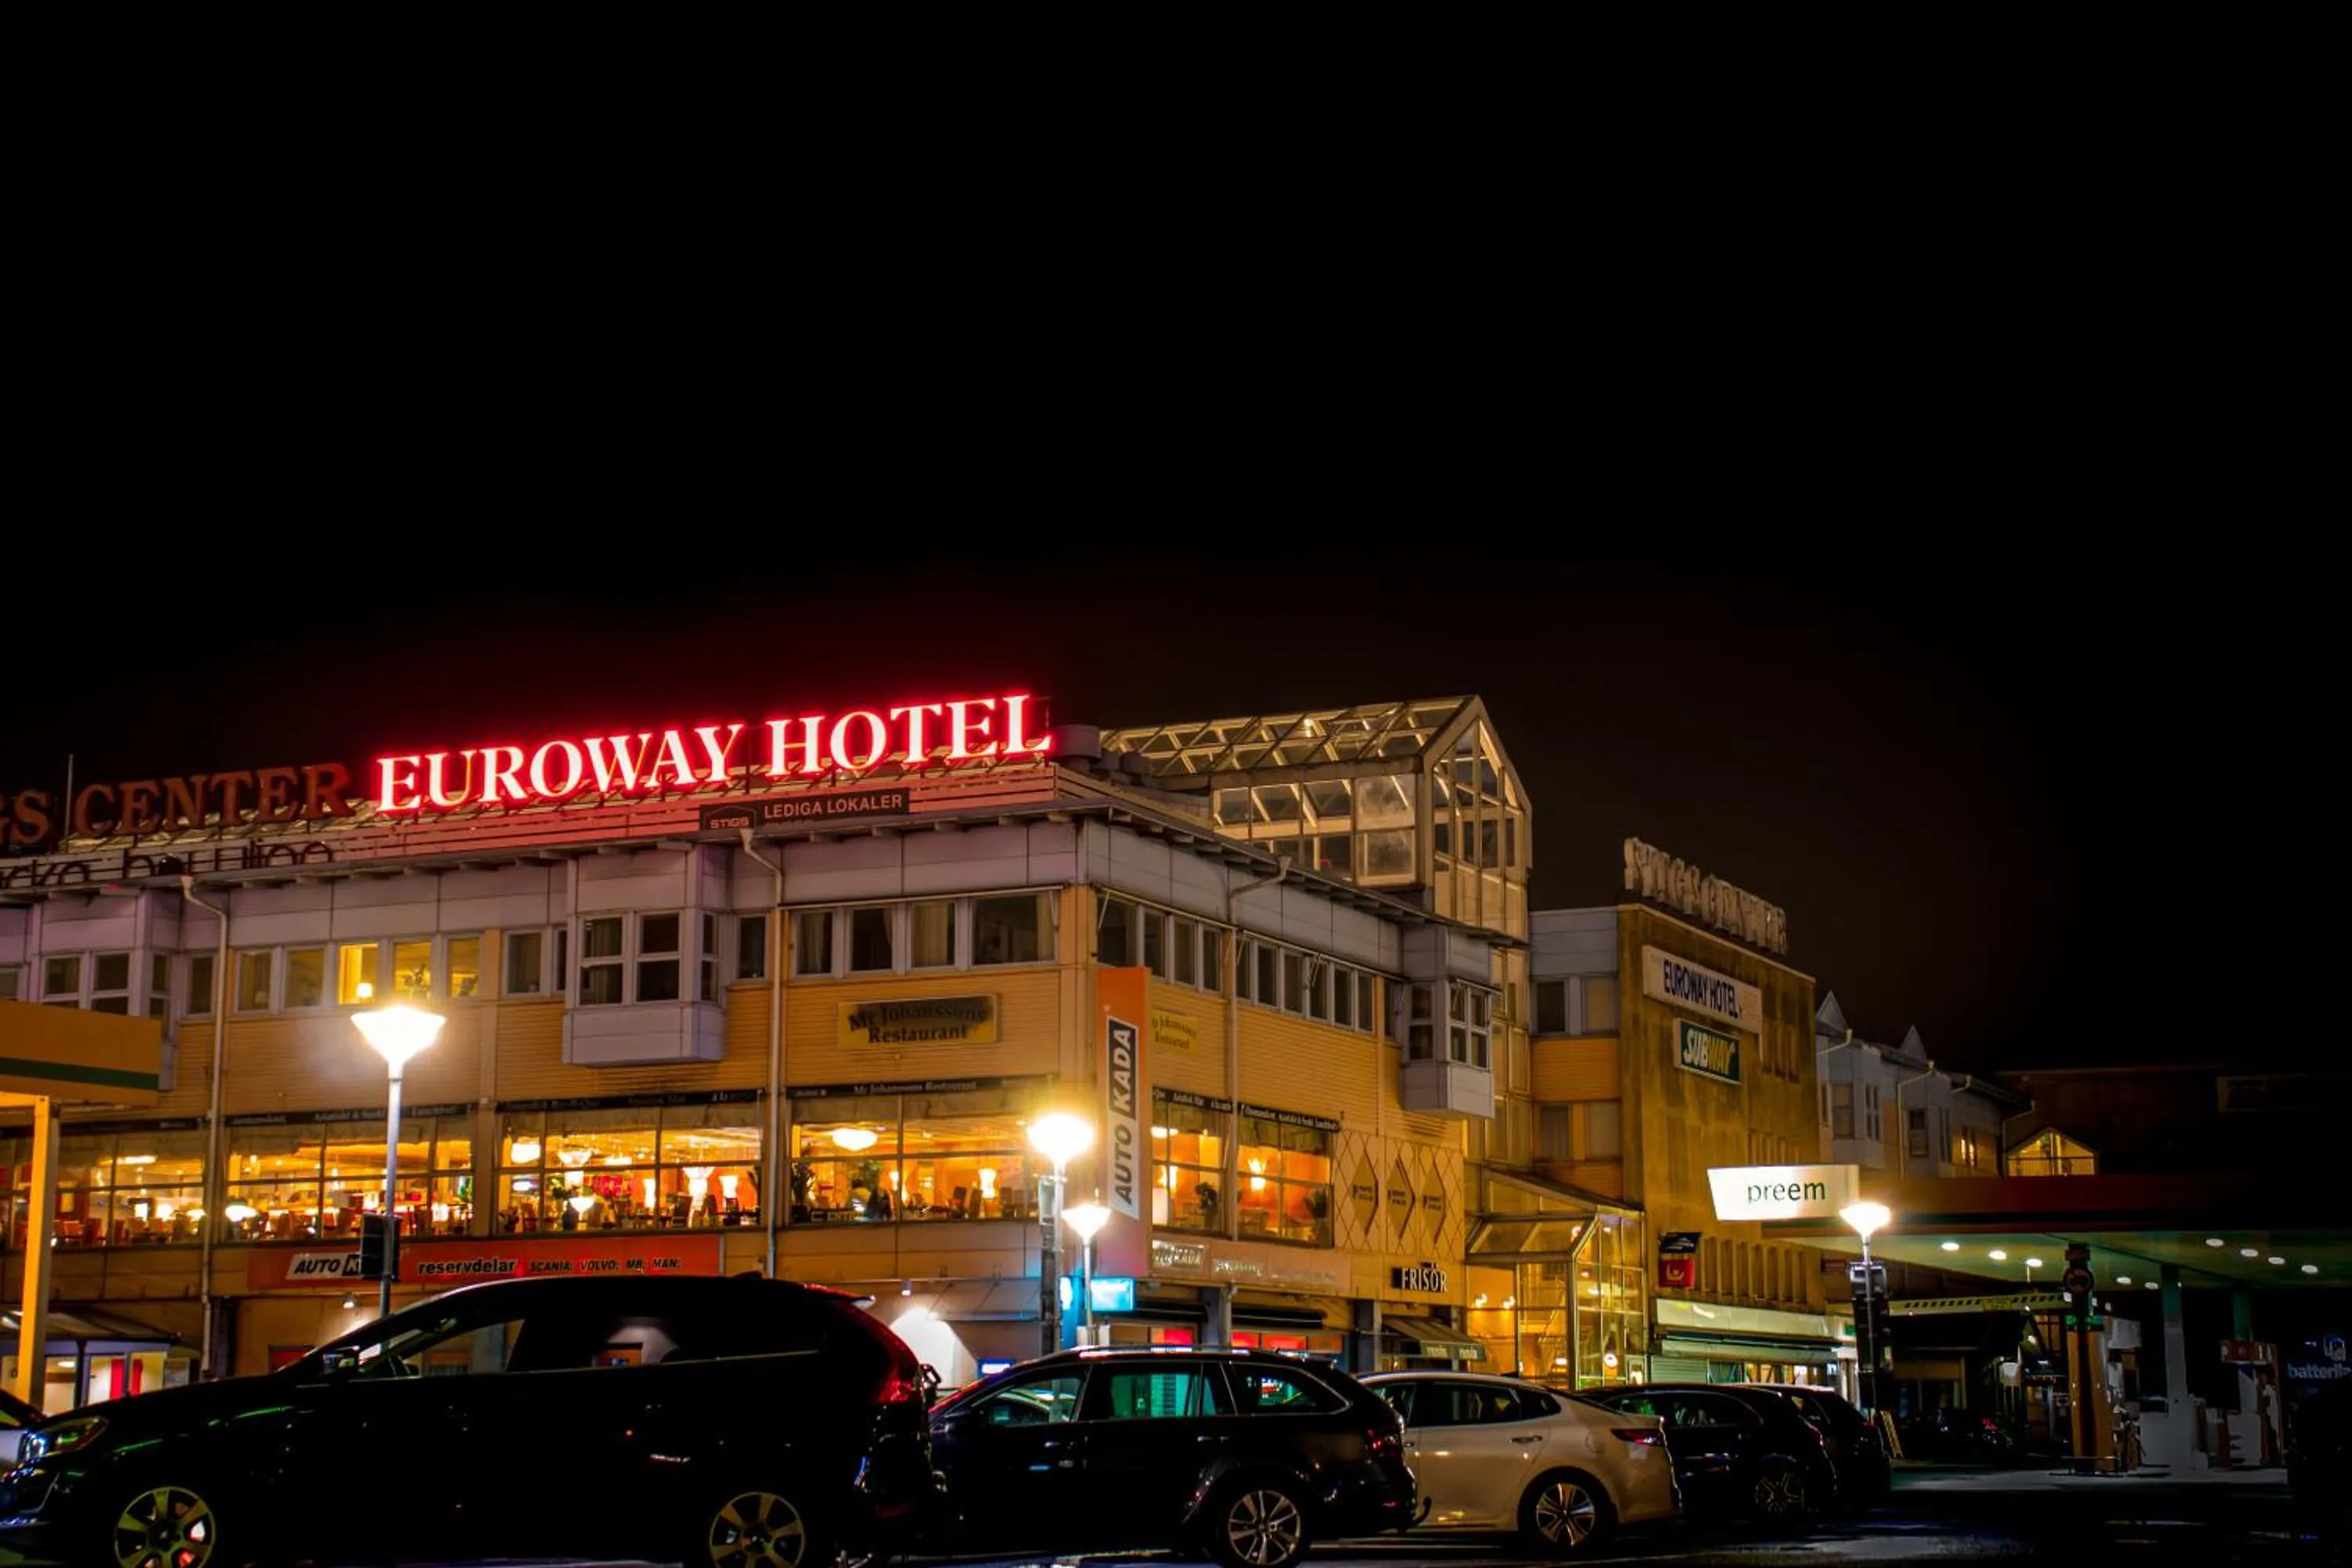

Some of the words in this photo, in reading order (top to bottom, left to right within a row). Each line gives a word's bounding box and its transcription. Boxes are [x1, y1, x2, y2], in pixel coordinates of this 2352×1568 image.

[376, 723, 744, 811] EUROWAY
[764, 695, 1051, 778] HOTEL
[73, 762, 357, 838] CENTER
[764, 800, 822, 819] LEDIGA
[827, 794, 902, 813] LOKALER
[1663, 959, 1708, 1005] EUROWAY
[1709, 976, 1739, 1019] HOTEL
[867, 1022, 967, 1044] Restaurant
[1683, 1028, 1735, 1075] SUBWAY
[1113, 1029, 1131, 1111] KADA
[1115, 1123, 1132, 1206] AUTO
[1748, 1181, 1825, 1204] preem
[294, 1258, 341, 1274] AUTO
[418, 1258, 515, 1275] reservdelar
[1402, 1262, 1448, 1292] FRISÖR
